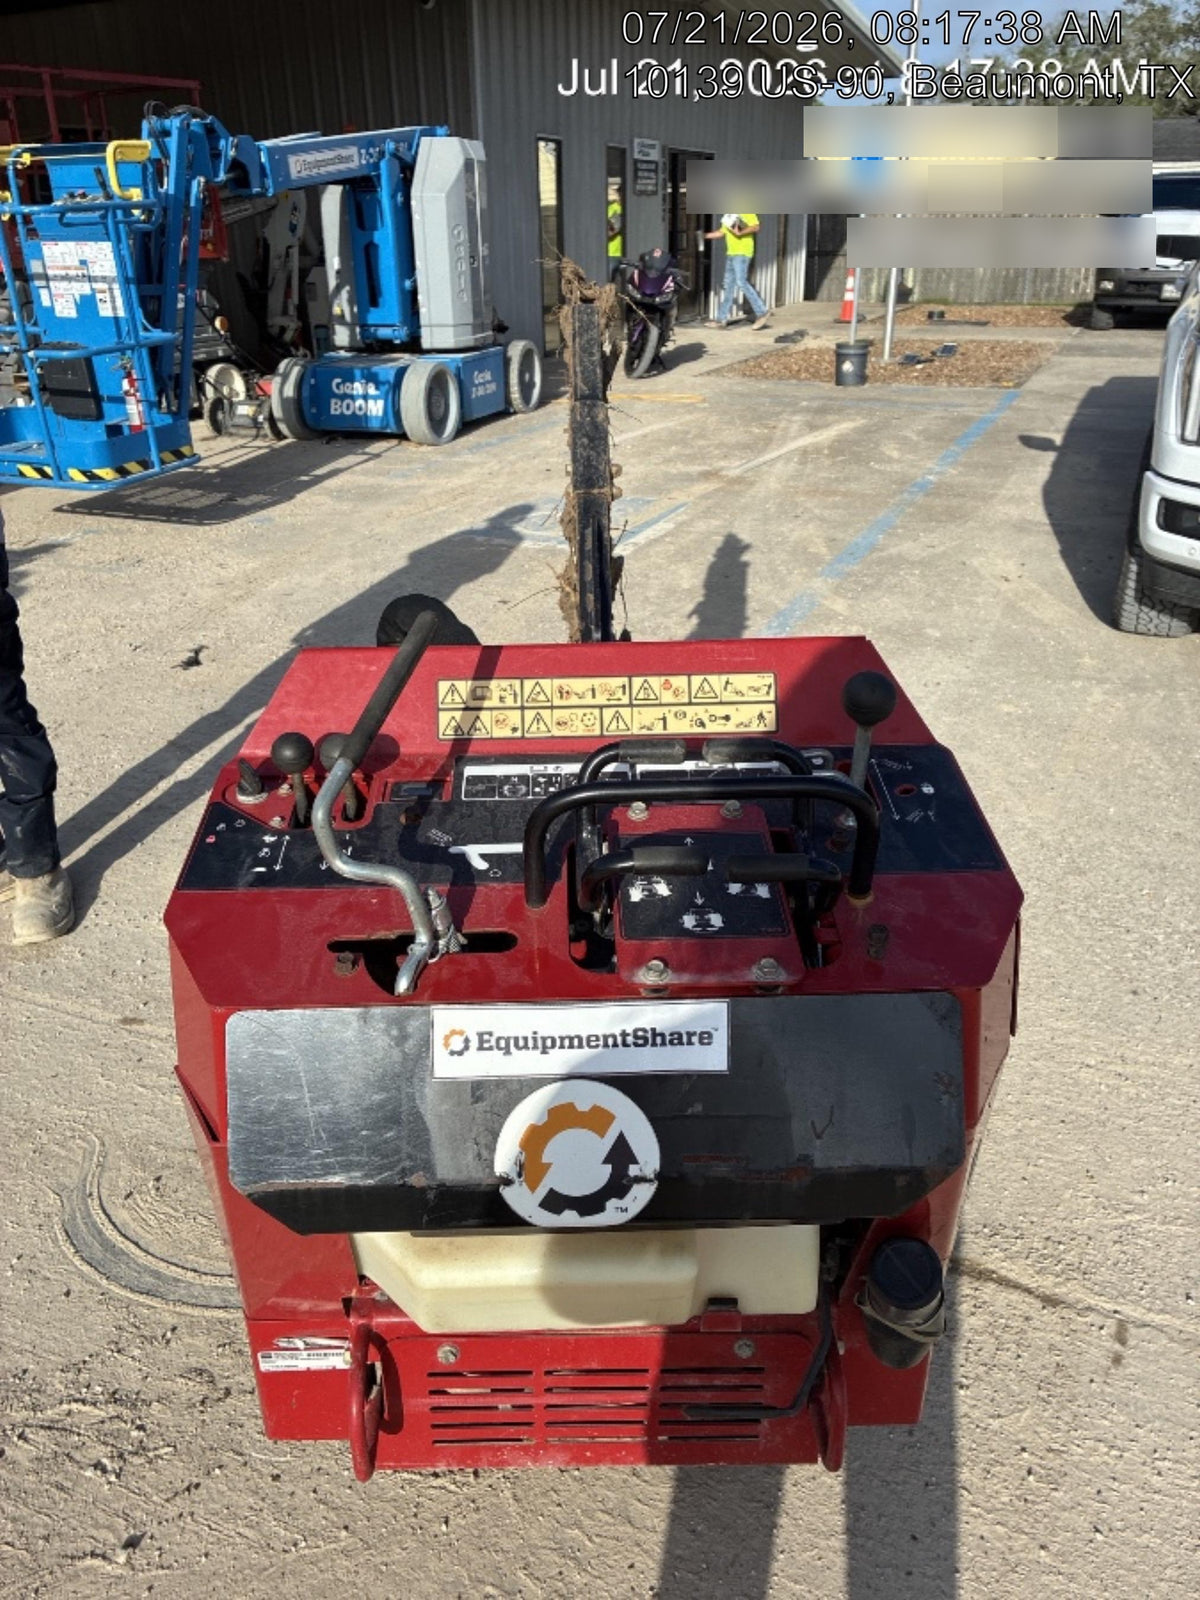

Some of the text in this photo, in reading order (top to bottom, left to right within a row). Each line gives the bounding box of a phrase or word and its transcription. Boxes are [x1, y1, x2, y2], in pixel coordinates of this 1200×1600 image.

[331, 377, 381, 396] Genie
[330, 398, 385, 417] BOOM
[475, 1026, 715, 1055] EquipmentShare
